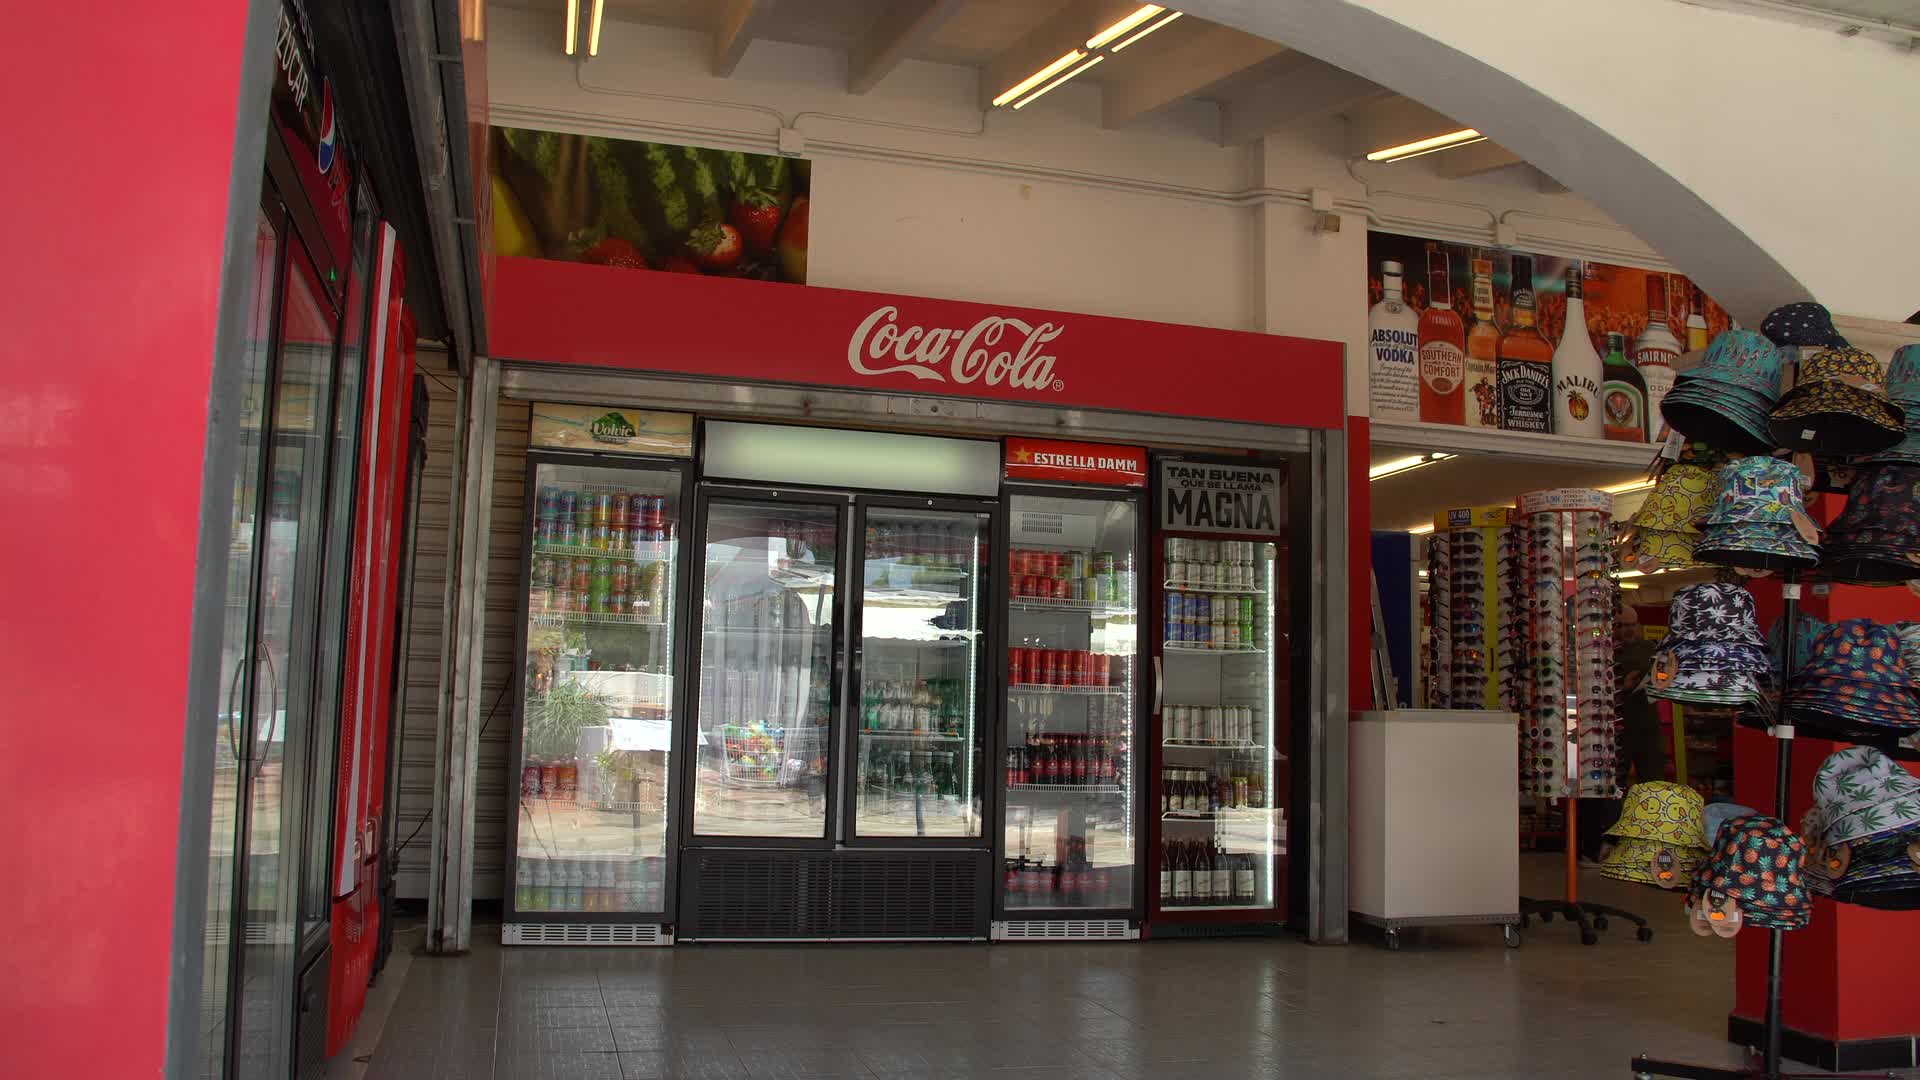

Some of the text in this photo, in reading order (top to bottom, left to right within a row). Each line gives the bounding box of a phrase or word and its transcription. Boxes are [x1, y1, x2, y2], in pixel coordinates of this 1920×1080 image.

[1372, 328, 1418, 347] ABSOLUT
[848, 305, 1064, 391] Coca-Cola
[1376, 347, 1415, 365] VODKA
[1421, 349, 1461, 364] SOUTHERN
[1423, 364, 1460, 378] COMFORT
[1501, 368, 1521, 385] JACK
[1556, 375, 1600, 399] MALIBU
[593, 423, 632, 437] Volvic
[1507, 419, 1546, 430] WHISKEY
[1033, 452, 1138, 472] ESTRELLA DAMM
[1167, 466, 1274, 484] TAN BUENA
[1181, 479, 1262, 492] QUE SE LLAMA
[1167, 489, 1275, 531] MAGNA
[1457, 510, 1470, 520] 400
